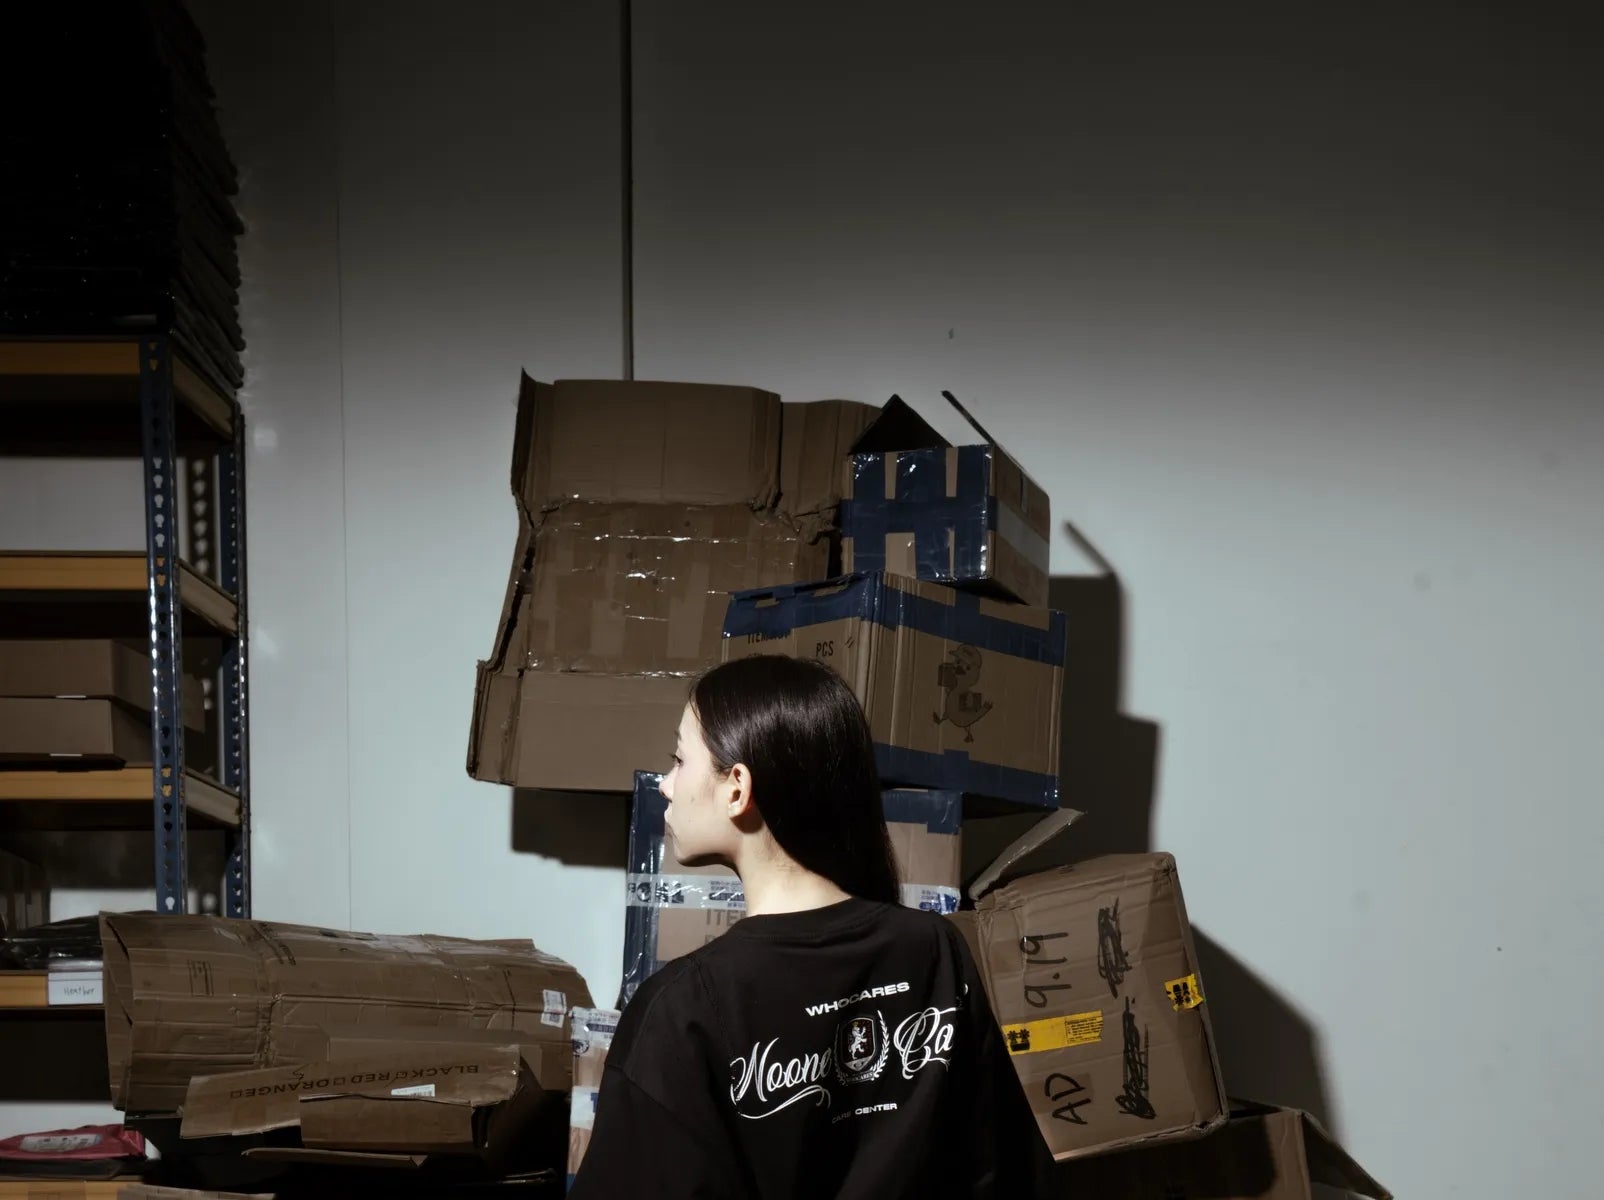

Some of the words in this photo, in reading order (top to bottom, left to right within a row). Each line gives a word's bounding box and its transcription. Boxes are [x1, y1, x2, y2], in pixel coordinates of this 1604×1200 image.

[816, 640, 834, 657] PCS
[1020, 931, 1071, 1008] 9.19
[805, 981, 911, 1017] WHOCARES
[351, 1070, 391, 1085] RED
[411, 1064, 480, 1079] BLACK
[729, 1037, 833, 1109] Noone
[246, 1078, 330, 1099] ORANGE
[1044, 1073, 1091, 1125] AD
[855, 1102, 898, 1116] CENTER
